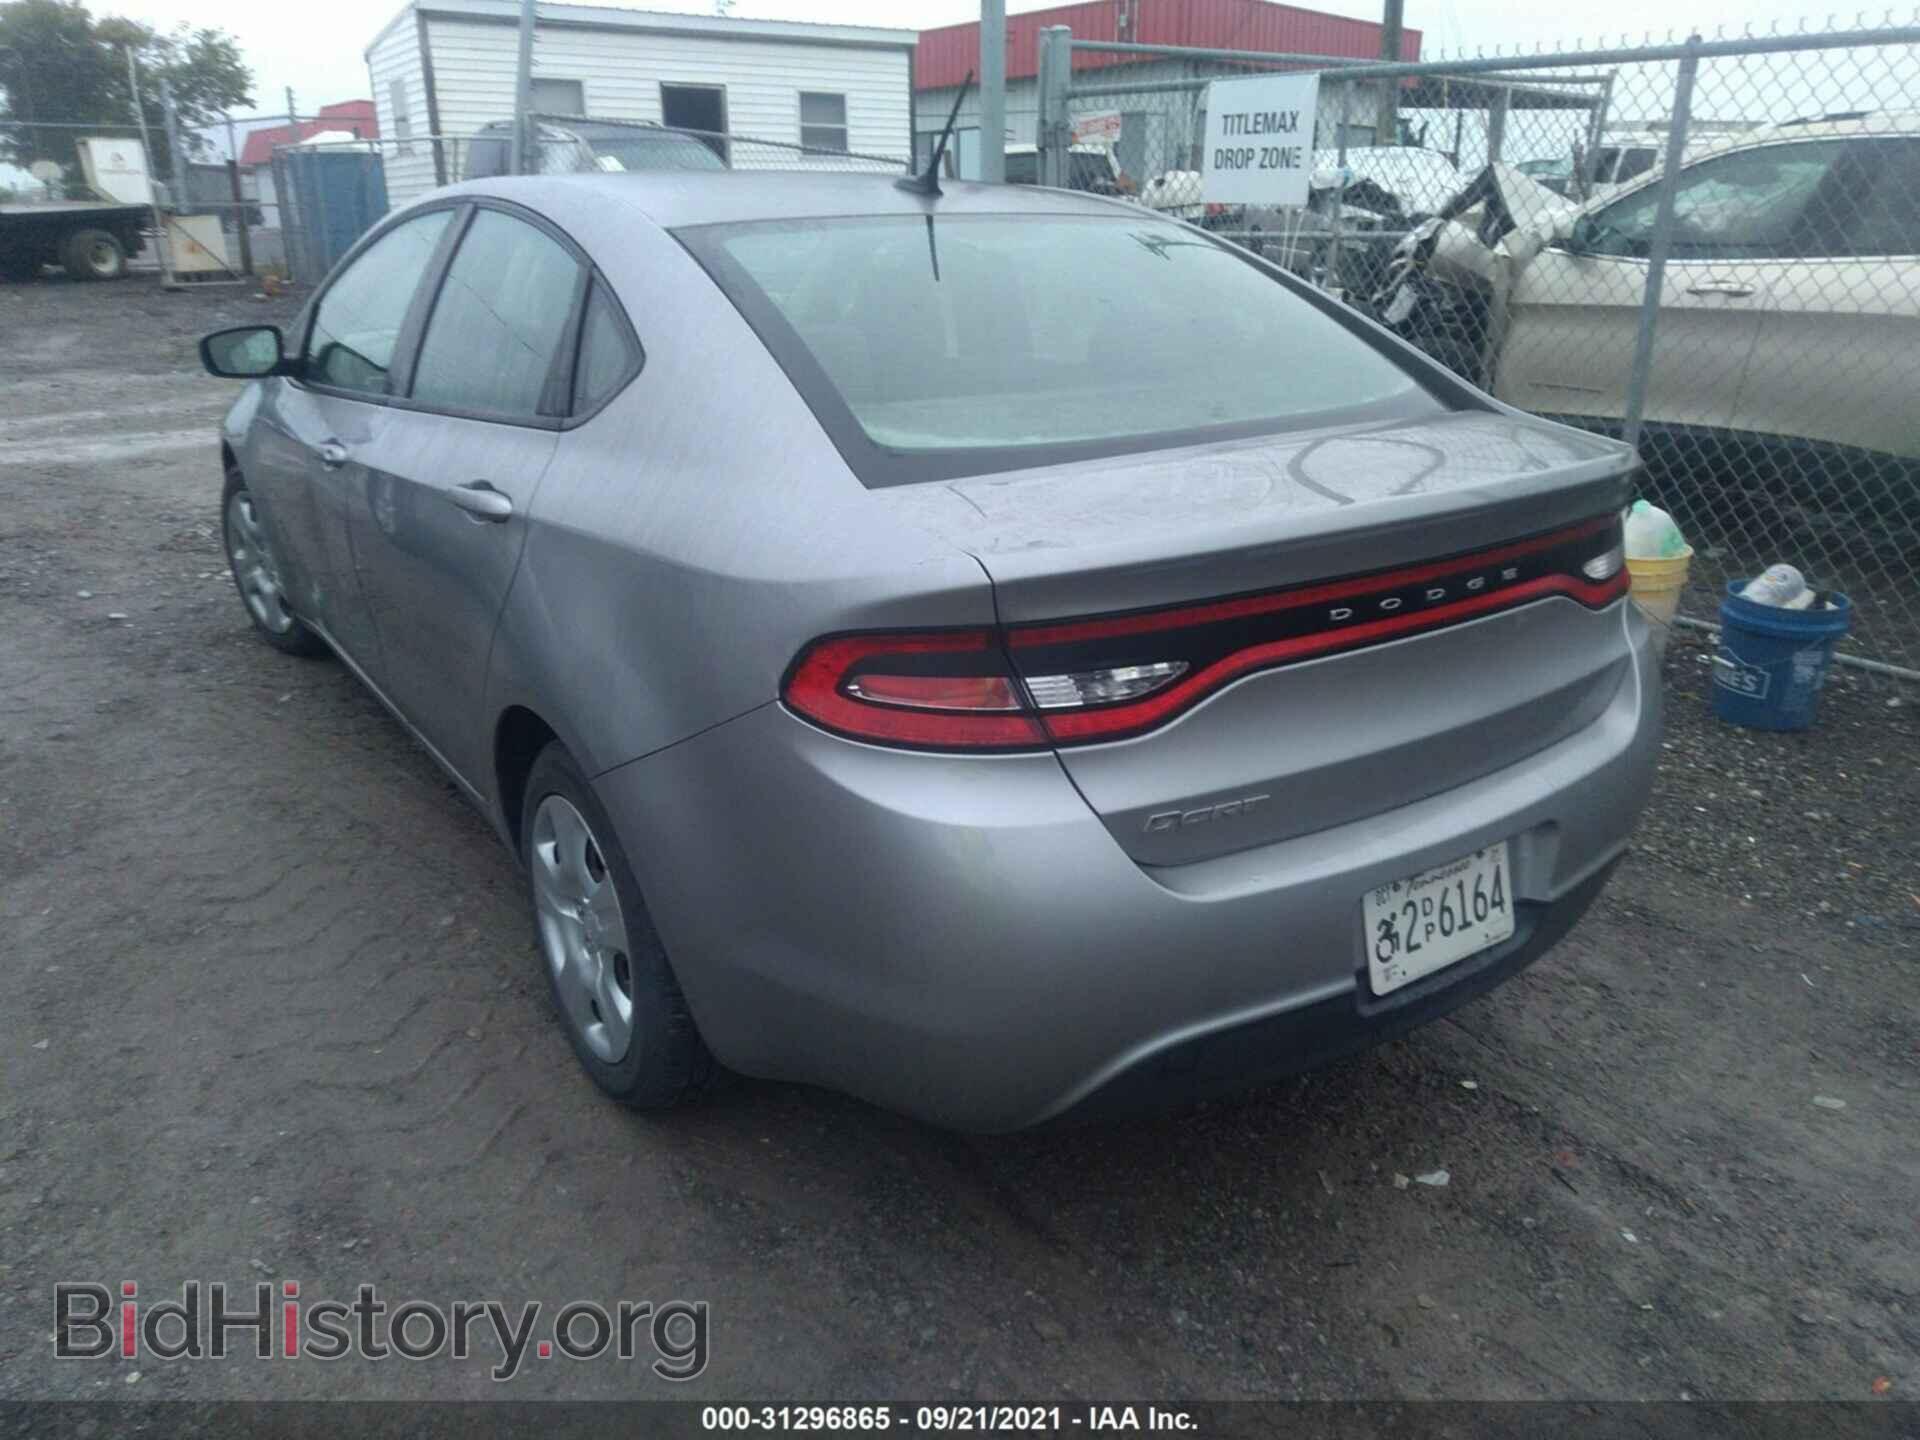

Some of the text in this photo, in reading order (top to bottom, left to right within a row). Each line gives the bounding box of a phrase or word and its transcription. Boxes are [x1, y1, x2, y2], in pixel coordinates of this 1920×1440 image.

[1222, 110, 1300, 136] TITLEMAX
[1214, 146, 1302, 170] DROP ZONE
[1329, 567, 1518, 621] DODGE
